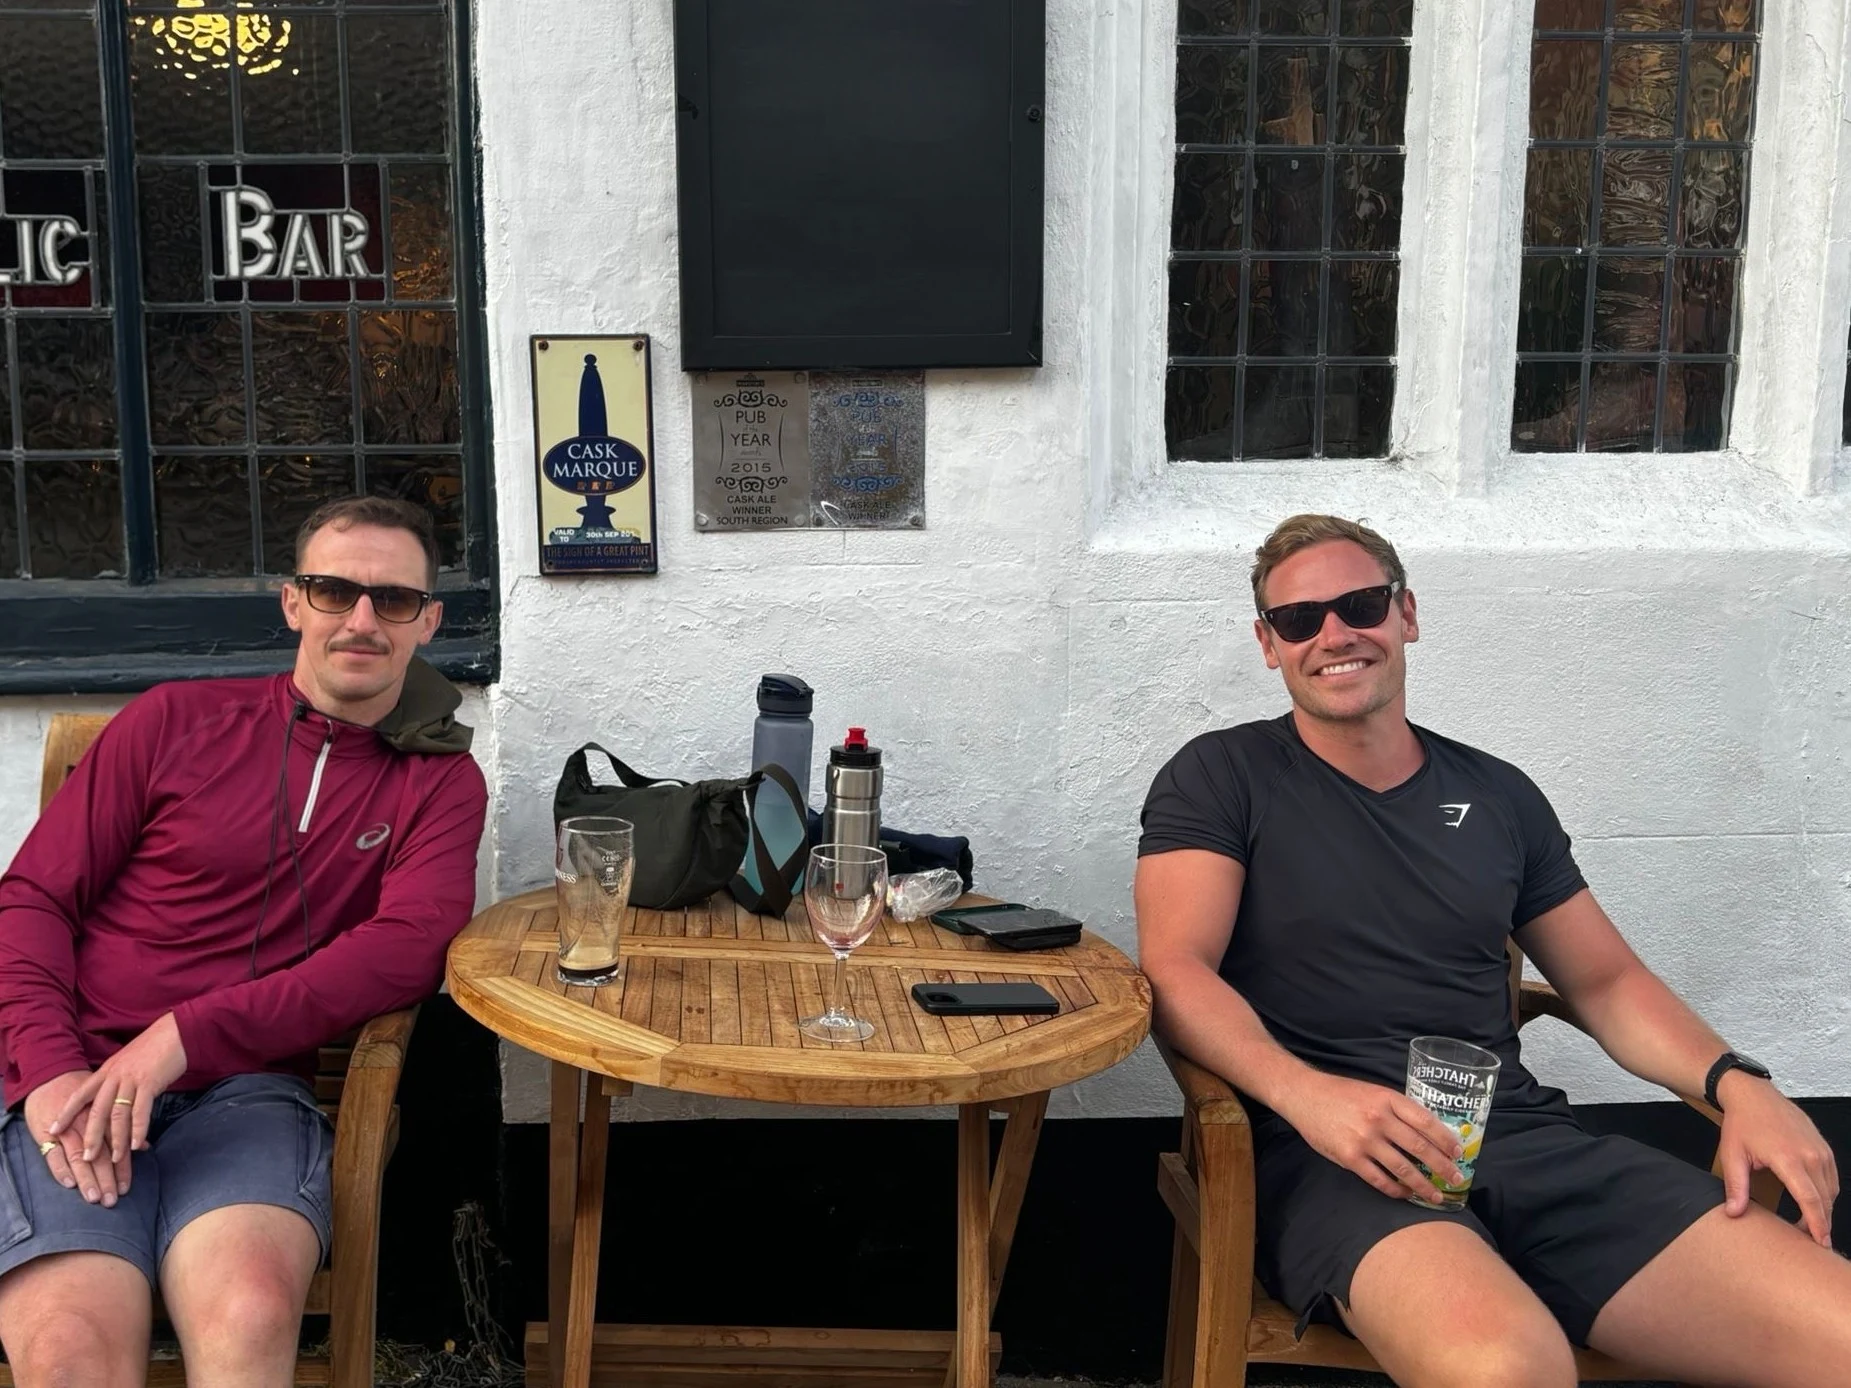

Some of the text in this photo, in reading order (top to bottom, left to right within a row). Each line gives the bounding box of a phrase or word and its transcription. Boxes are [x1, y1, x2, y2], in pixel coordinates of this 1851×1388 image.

[735, 410, 767, 424] PUB
[730, 433, 772, 447] YEAR
[845, 434, 888, 446] YEAR
[567, 443, 619, 460] CASK
[552, 461, 639, 479] MARQUE
[731, 462, 772, 473] 2015
[727, 495, 777, 504] CASK ALE
[731, 506, 772, 515] WINNER
[716, 516, 788, 526] SOUTH REGION
[604, 530, 620, 538] SEP
[547, 546, 562, 558] THE
[584, 545, 595, 557] OF
[596, 545, 602, 556] A
[603, 545, 628, 557] GREAT
[630, 544, 649, 556] PINT
